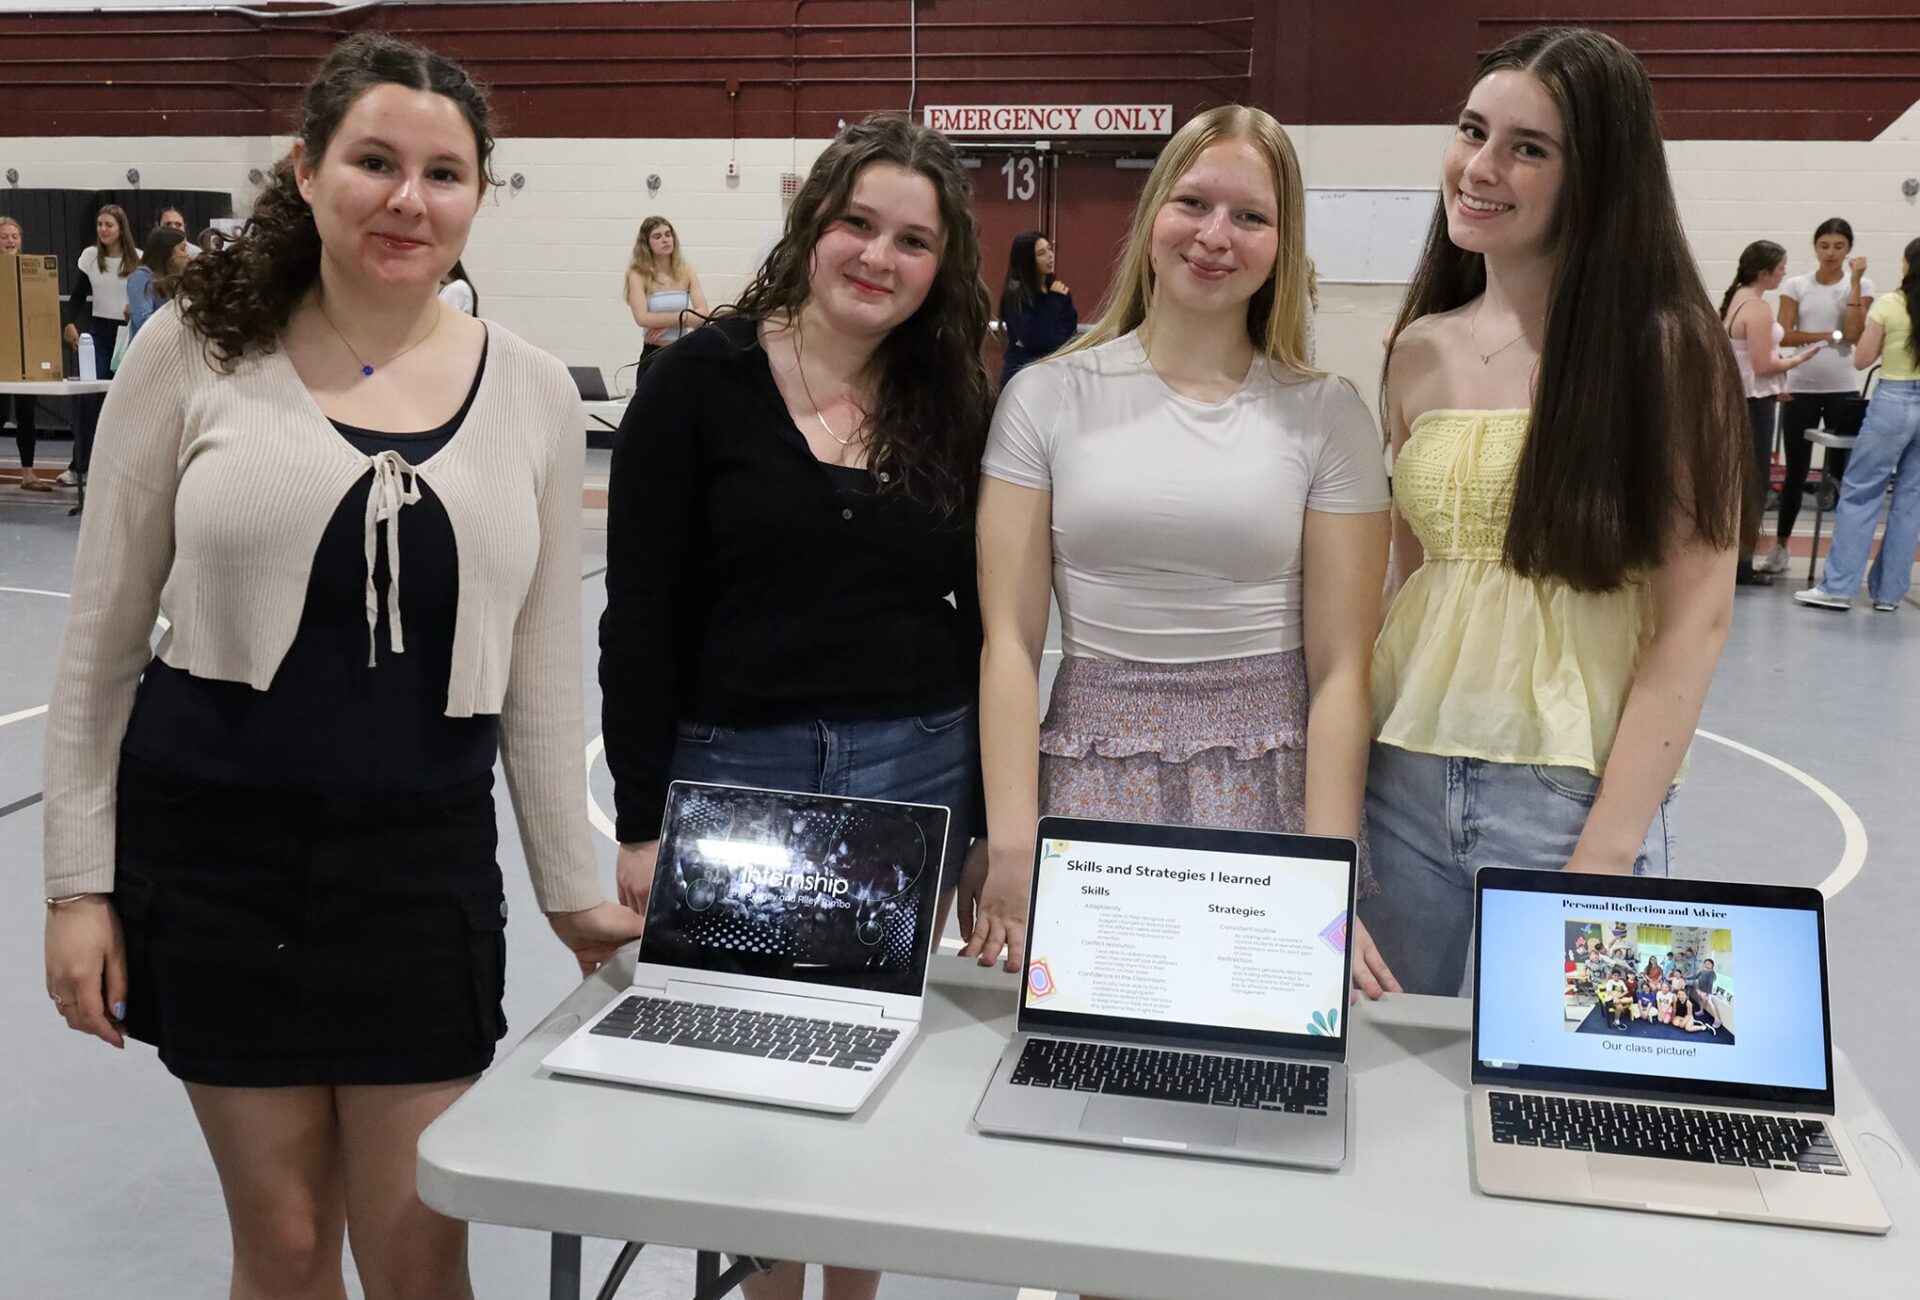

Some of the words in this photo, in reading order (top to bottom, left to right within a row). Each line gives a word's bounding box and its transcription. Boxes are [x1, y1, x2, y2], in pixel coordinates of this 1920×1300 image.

[929, 108, 1082, 131] EMERGENCY
[1095, 108, 1167, 131] ONLY
[1001, 157, 1036, 201] 13
[742, 864, 849, 898] Internship
[1067, 860, 1102, 873] Skills
[1106, 864, 1132, 875] and
[1136, 866, 1206, 882] Strategies
[1210, 871, 1214, 882] I
[1218, 871, 1271, 886] learned
[1081, 886, 1110, 896] Skills
[1208, 904, 1266, 918] Strategies
[1562, 899, 1609, 911] Personal
[1611, 903, 1666, 914] Reflection
[1668, 907, 1689, 916] and
[1692, 908, 1728, 919] Advice
[1218, 956, 1253, 964] Redirection
[1602, 1040, 1622, 1050] Our
[1625, 1043, 1653, 1054] class
[1656, 1046, 1697, 1057] picture!
